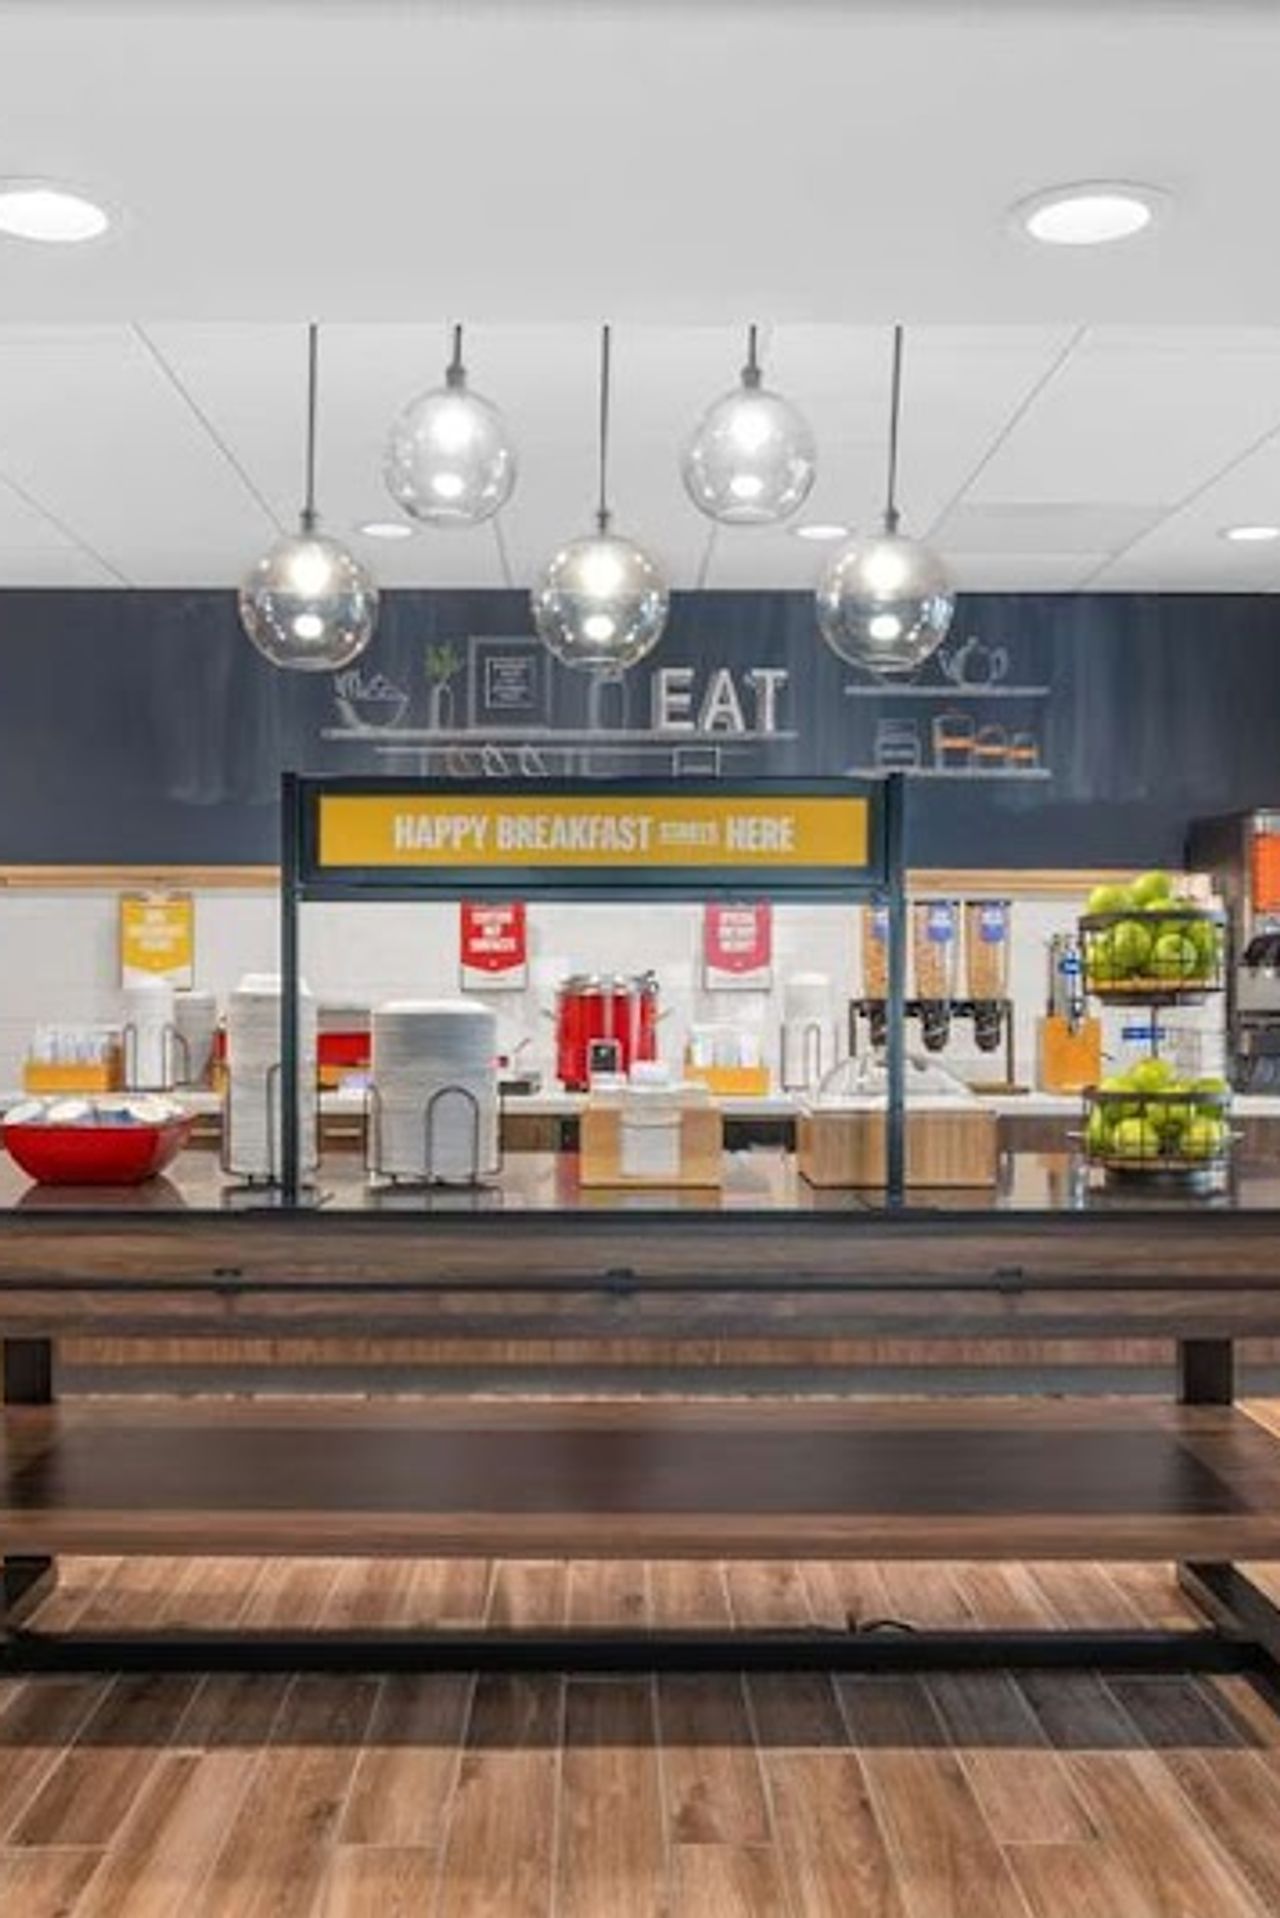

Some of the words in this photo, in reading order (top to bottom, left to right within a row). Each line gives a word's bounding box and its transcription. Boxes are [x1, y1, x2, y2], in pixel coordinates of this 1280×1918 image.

[651, 668, 788, 732] EAT
[393, 814, 488, 851] HAPPY
[496, 814, 652, 851] BREAKFAST
[725, 814, 796, 853] HERE
